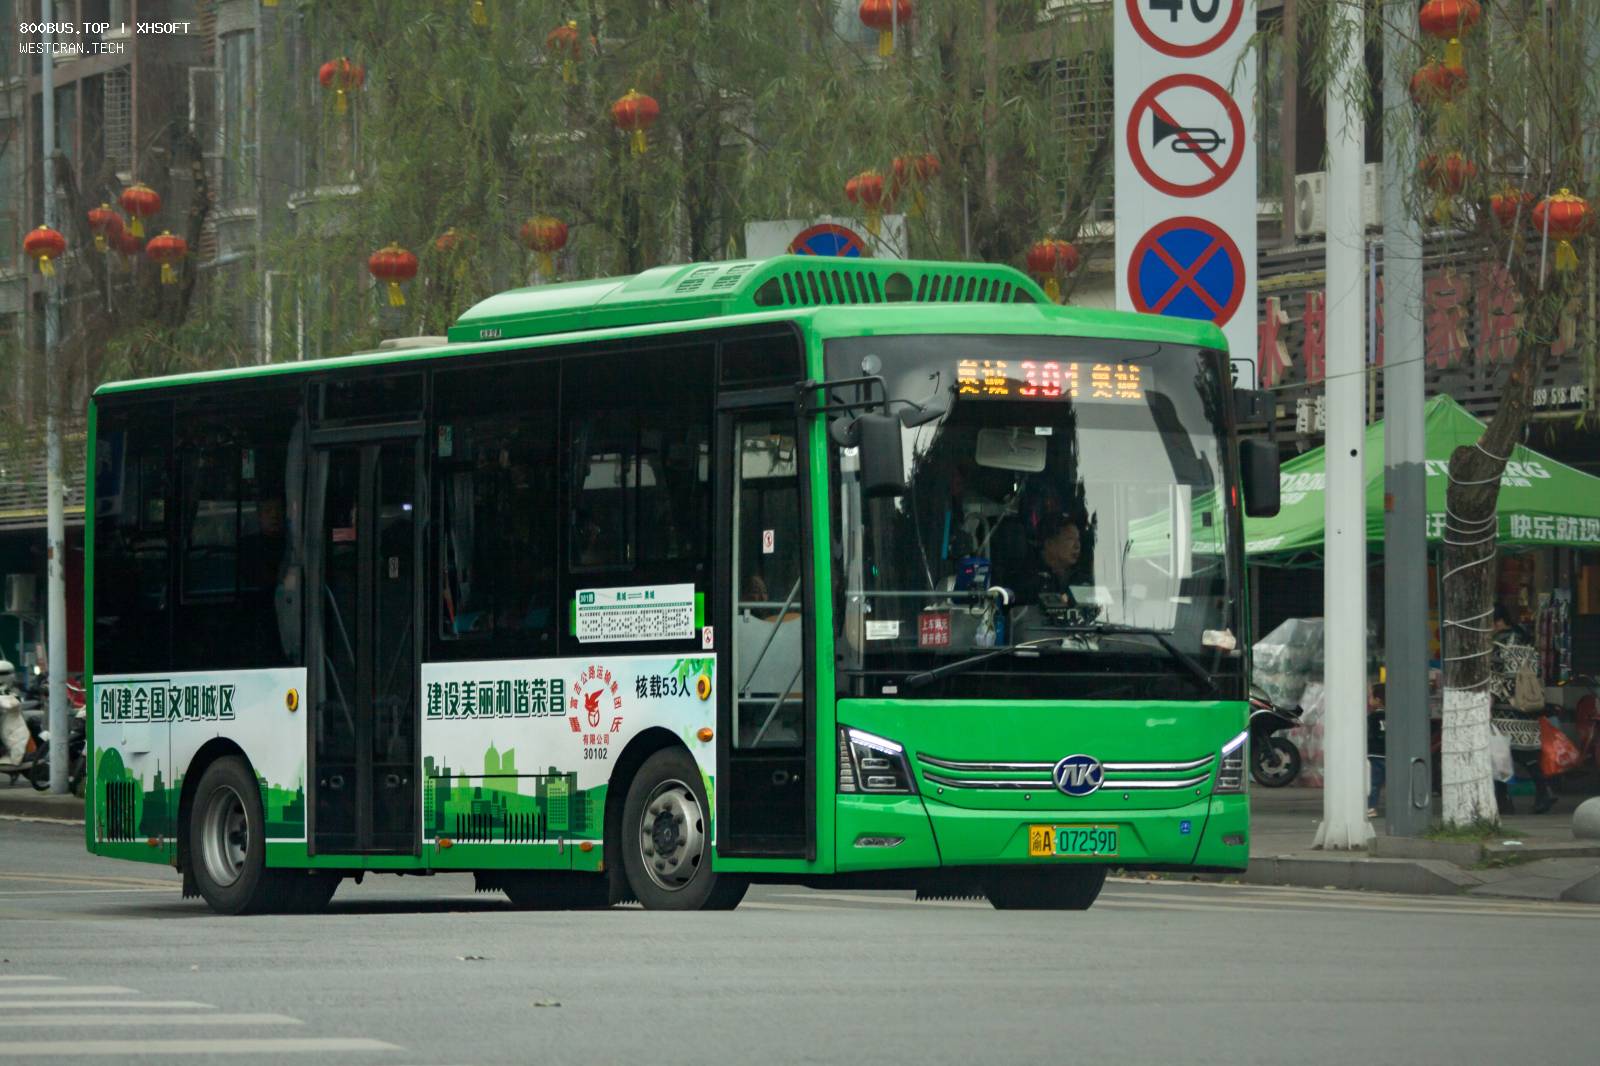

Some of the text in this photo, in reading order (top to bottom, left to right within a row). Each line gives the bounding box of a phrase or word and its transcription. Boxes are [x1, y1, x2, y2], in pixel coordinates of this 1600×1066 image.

[1019, 361, 1079, 397] 301
[427, 678, 566, 720] 建设美丽和谐荣昌
[635, 674, 690, 699] 核载53人
[100, 684, 236, 724] 创建全国文明城区
[583, 733, 610, 745] 有限公司
[583, 747, 608, 760] 30102
[1059, 830, 1117, 852] 07259D
